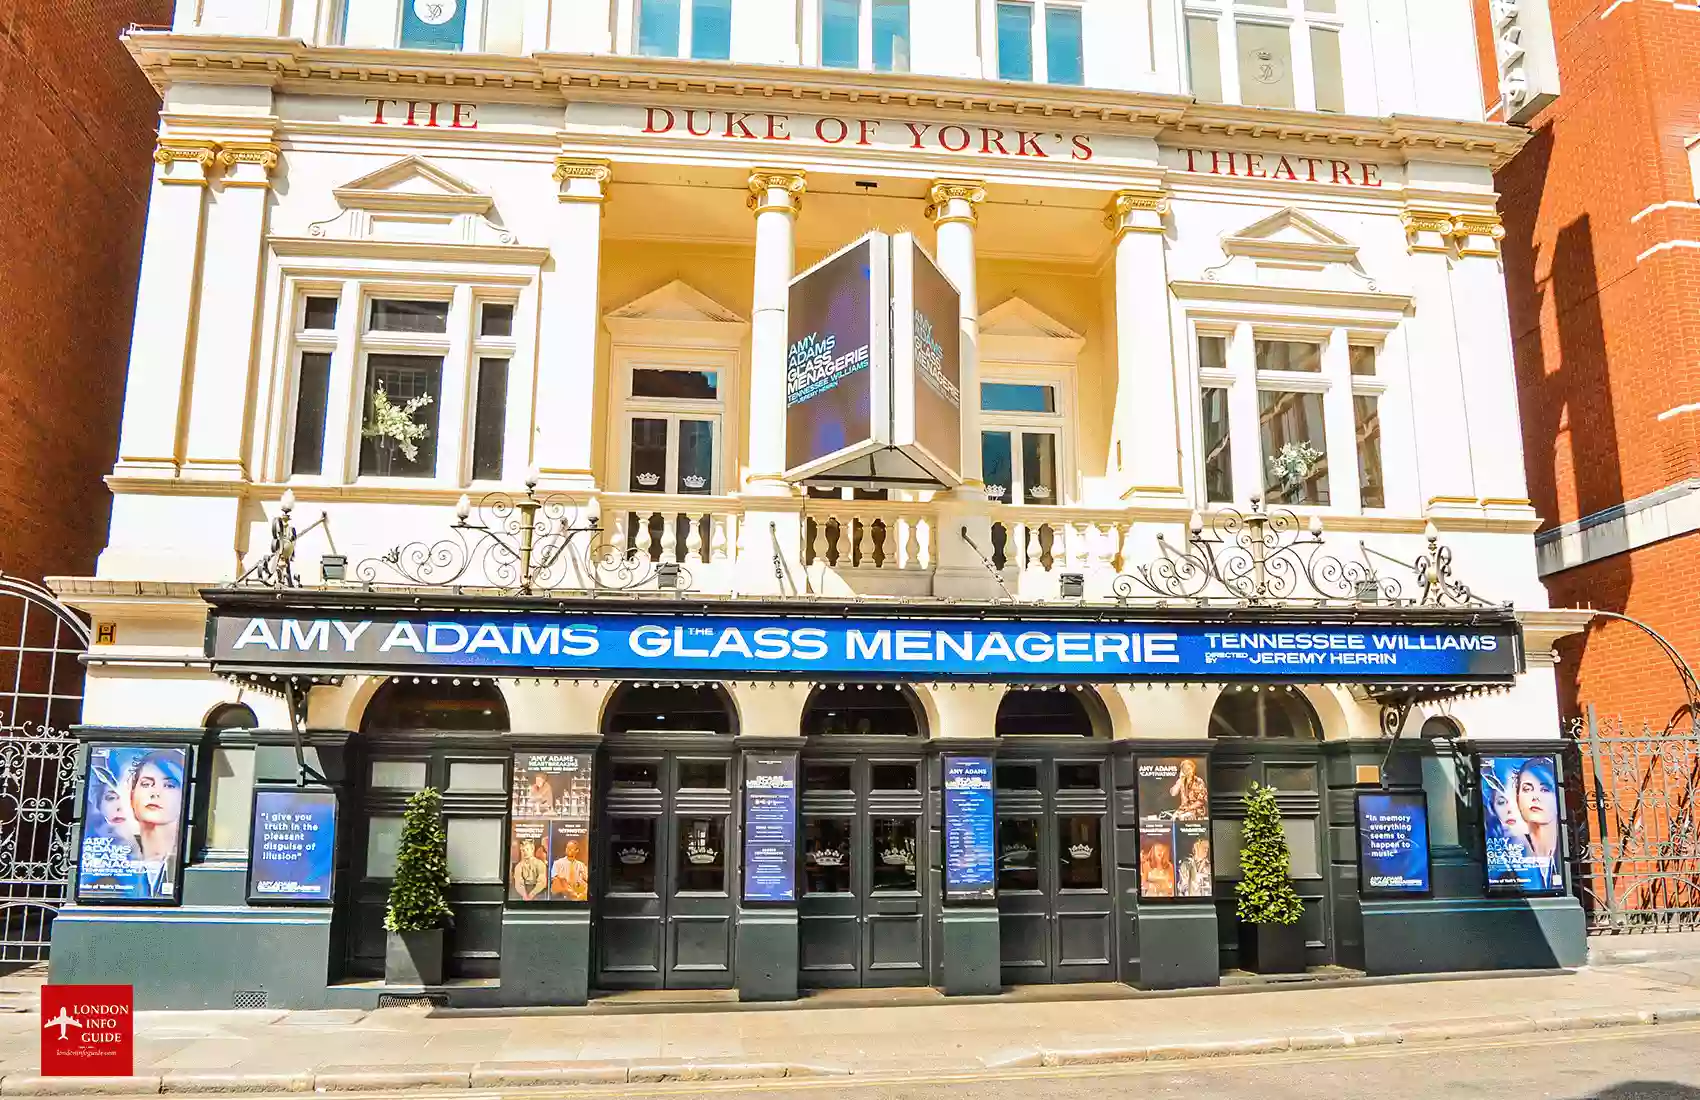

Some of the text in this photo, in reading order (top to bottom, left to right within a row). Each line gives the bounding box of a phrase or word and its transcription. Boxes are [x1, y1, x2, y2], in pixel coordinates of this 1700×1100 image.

[365, 99, 477, 129] THE
[641, 107, 1093, 160] DUKE OF YORK'S
[1178, 148, 1382, 187] THEATRE
[789, 332, 817, 357] AMY
[788, 335, 836, 370] ADAMS
[787, 344, 869, 395] MENAGERIE
[788, 350, 832, 382] GLASS
[232, 617, 600, 656] AMY ADAMS
[687, 627, 714, 636] THE
[628, 624, 1180, 663] GLASS MENAGERIE
[1204, 633, 1497, 650] TENNESSEE WILLIAMS
[1249, 652, 1397, 665] JEREMY HERRIN
[272, 813, 292, 821] give
[295, 814, 312, 822] you
[264, 823, 319, 831] truth in the
[1370, 823, 1412, 831] everything
[83, 837, 113, 845] AMY
[264, 833, 305, 841] pleasant
[1487, 837, 1510, 845] AMY
[83, 845, 132, 853] ADAMS
[263, 842, 316, 851] disguise of
[1370, 840, 1400, 849] happen
